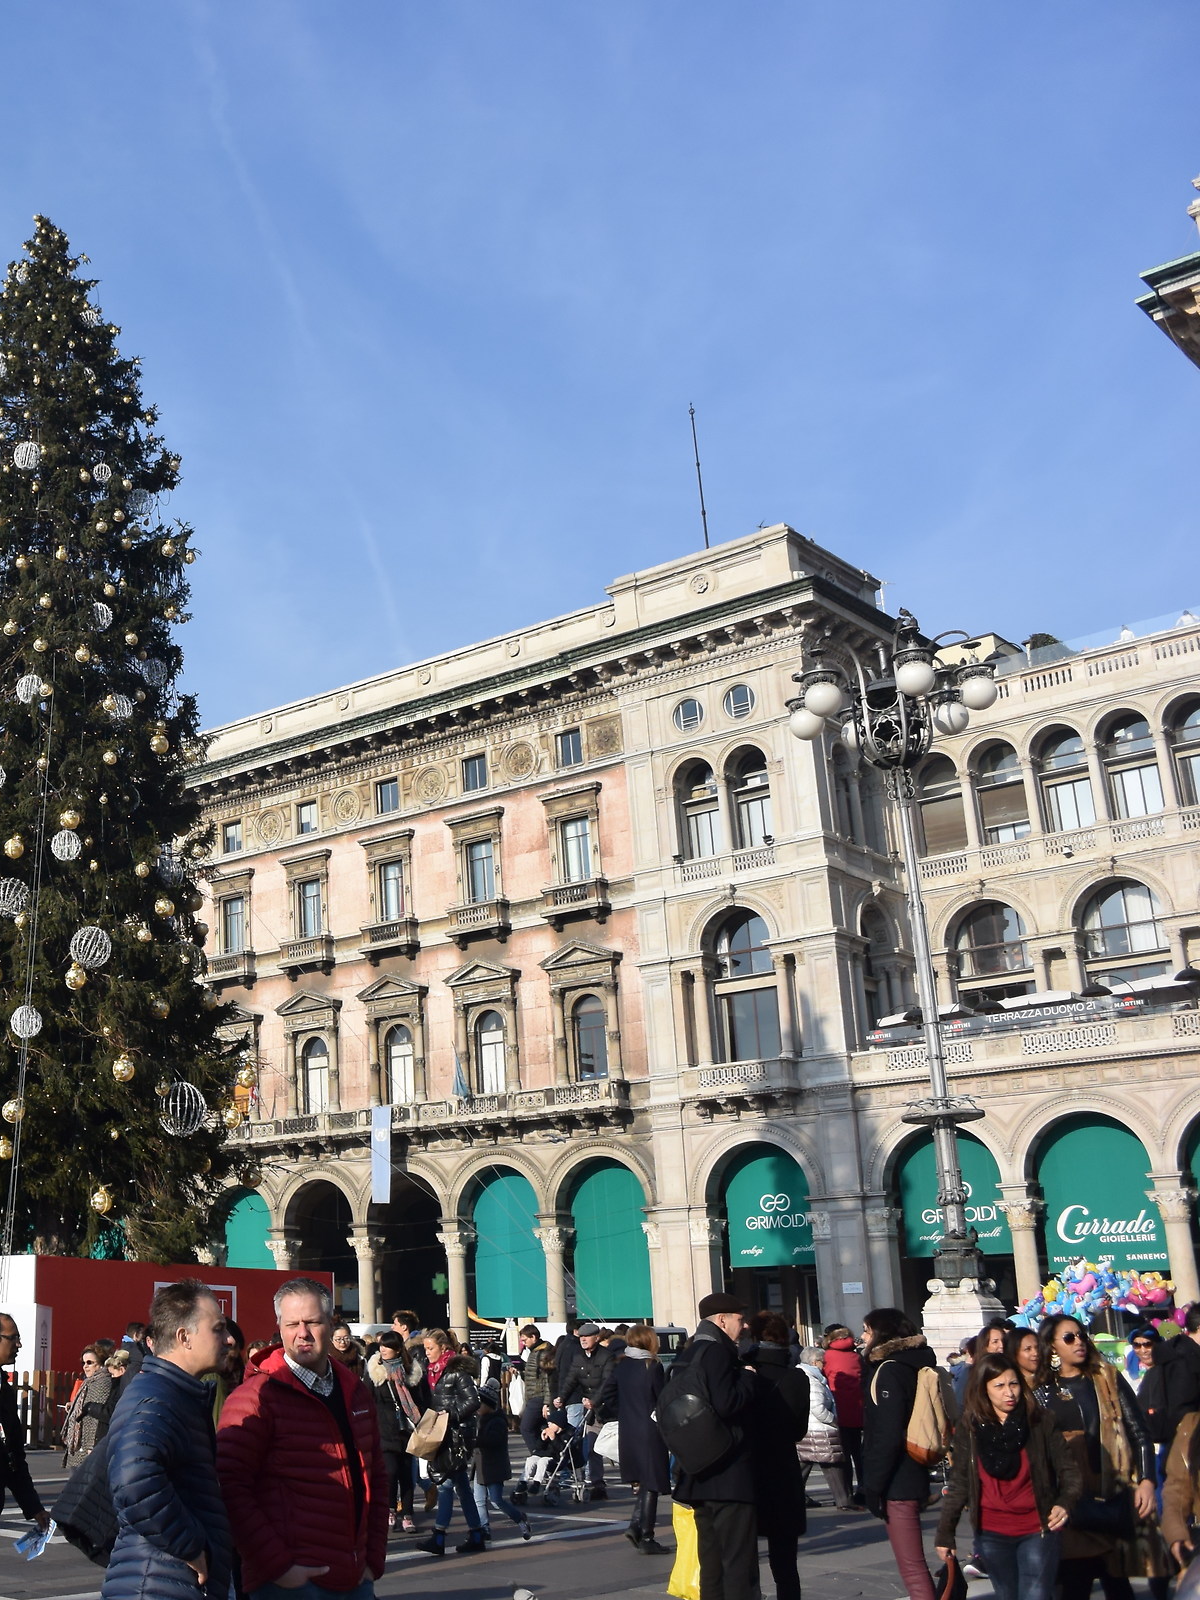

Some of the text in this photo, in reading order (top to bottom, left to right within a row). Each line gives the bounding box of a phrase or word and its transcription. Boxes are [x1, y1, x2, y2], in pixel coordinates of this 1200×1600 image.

[1113, 999, 1145, 1008] MARTINI
[986, 1001, 1097, 1023] TERRAZZA DUOMO 21
[943, 1021, 971, 1031] MARTINI
[865, 1032, 891, 1041] MARTINI
[921, 1206, 997, 1225] GROLDI
[745, 1213, 808, 1230] GRIMOLDI
[1056, 1204, 1156, 1244] Currado
[1099, 1233, 1157, 1243] GIOIELLERIE
[740, 1245, 764, 1256] orologi
[1098, 1254, 1115, 1262] ASTI
[1125, 1252, 1168, 1261] SANREMO
